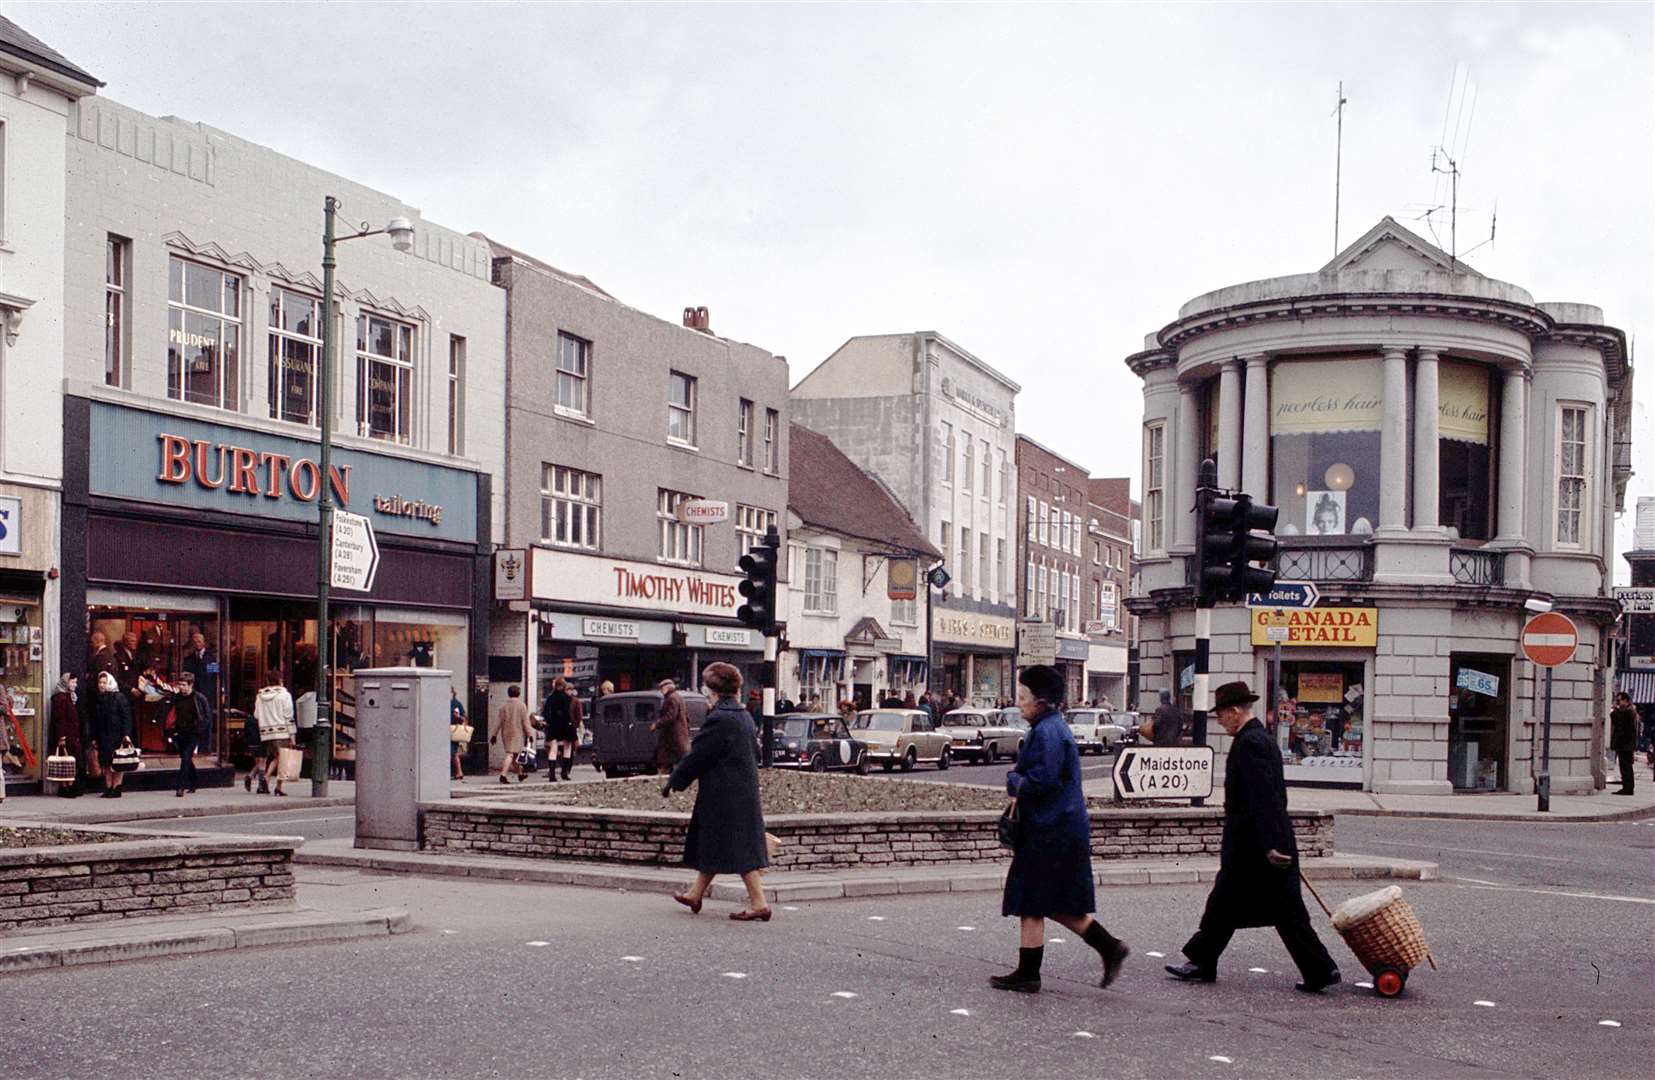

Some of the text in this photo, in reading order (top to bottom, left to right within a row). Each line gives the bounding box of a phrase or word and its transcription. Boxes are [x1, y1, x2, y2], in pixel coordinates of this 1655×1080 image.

[1276, 393, 1383, 416] peerless hair
[1462, 404, 1486, 422] hair
[158, 433, 352, 506] BURTON
[374, 494, 444, 525] tailoring
[686, 506, 725, 517] CHEMISTS
[335, 538, 364, 553] Canterbury
[334, 562, 363, 575] Faversham
[613, 567, 736, 608] TIMOTHY WHITES
[1258, 611, 1371, 626] GANADA
[590, 622, 634, 636] CHEMISTS
[1288, 627, 1356, 641] ETAIL
[712, 632, 745, 643] CHEMISTS
[1140, 757, 1208, 771] Maidstone
